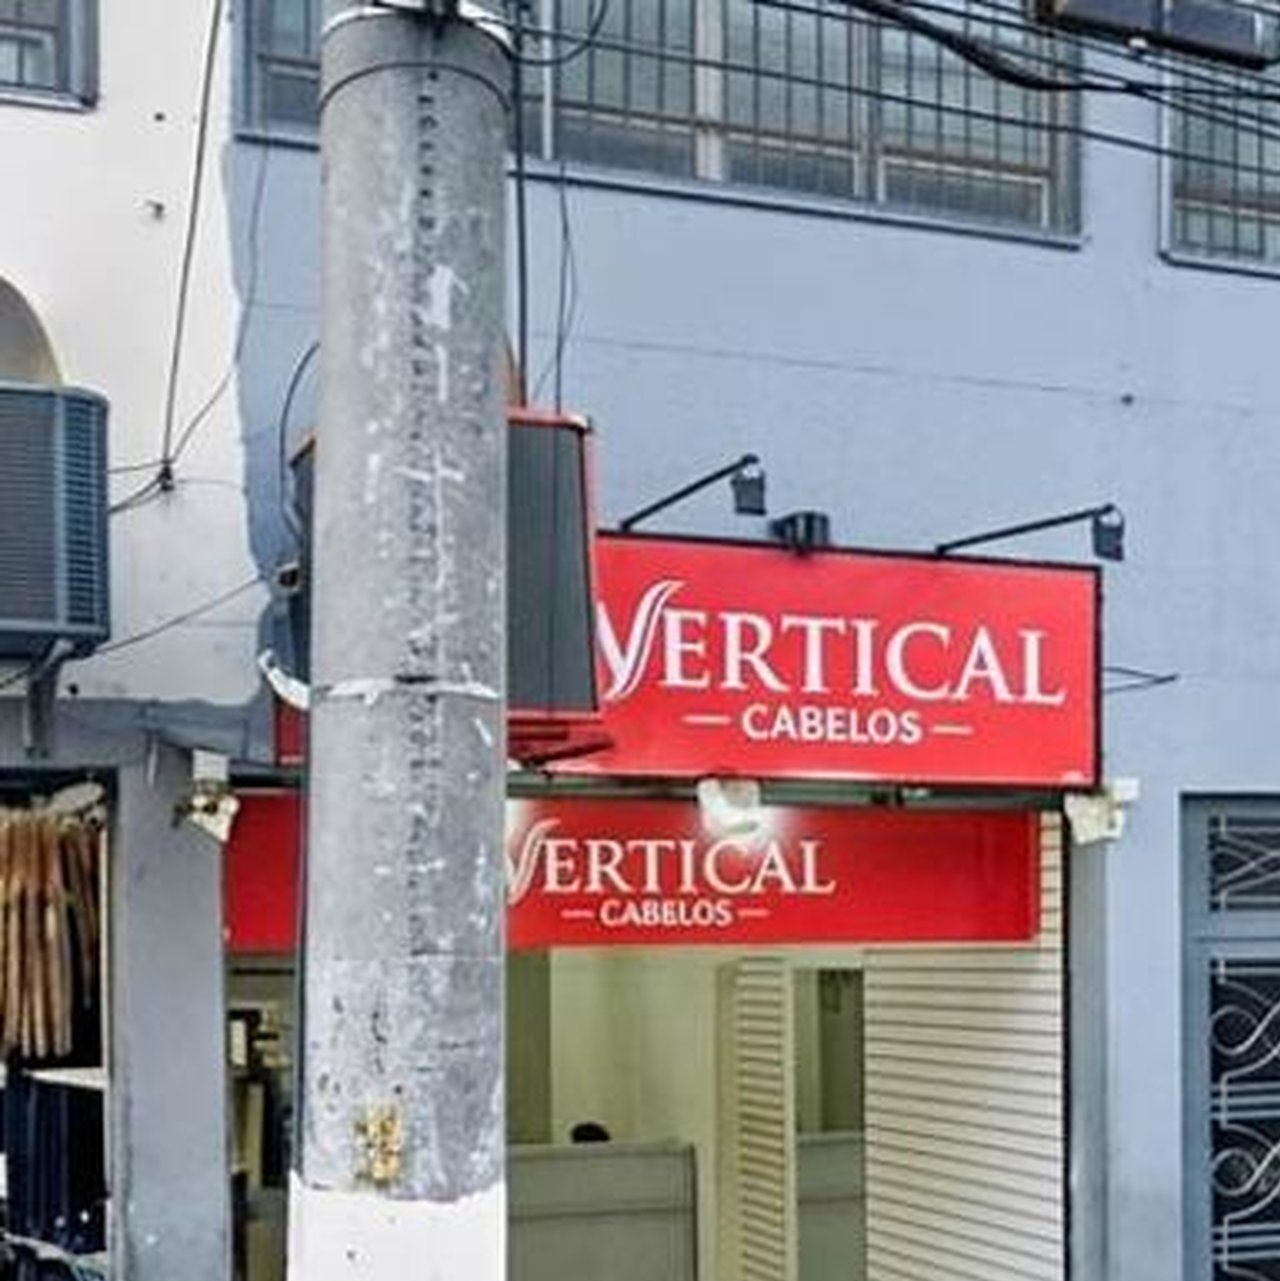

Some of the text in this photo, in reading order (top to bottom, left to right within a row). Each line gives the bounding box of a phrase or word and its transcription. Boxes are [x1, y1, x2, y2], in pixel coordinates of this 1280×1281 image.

[597, 580, 1066, 706] VERTICAL
[741, 704, 923, 743] CABELOS
[600, 899, 734, 926] CABELOS
